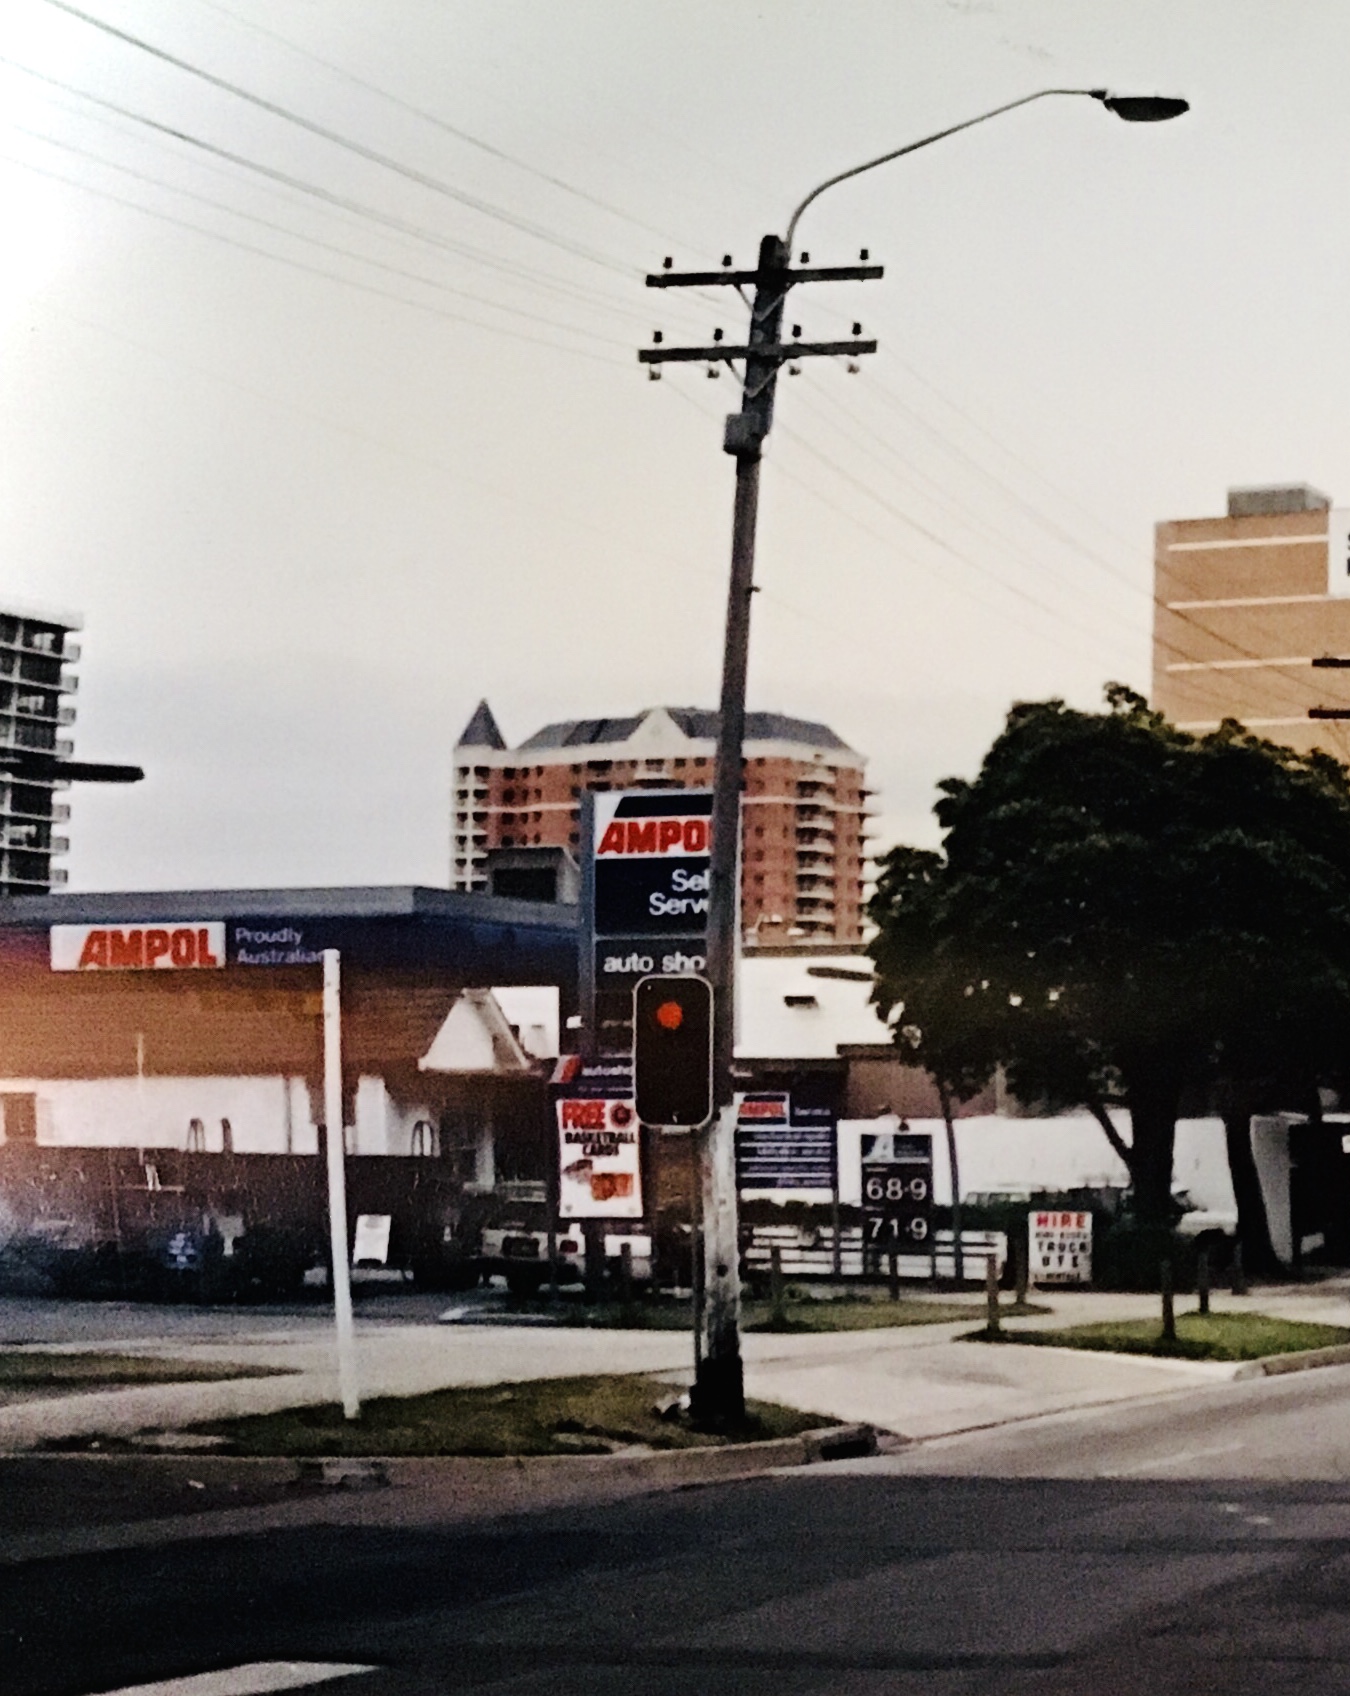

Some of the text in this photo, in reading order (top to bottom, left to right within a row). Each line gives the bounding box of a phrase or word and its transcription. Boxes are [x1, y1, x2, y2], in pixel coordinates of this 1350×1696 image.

[672, 869, 710, 892] Sel
[235, 927, 302, 945] Proudly
[79, 929, 217, 967] AMPOL
[604, 952, 706, 972] auto sho
[562, 1100, 606, 1130] FREE
[565, 1132, 635, 1144] BASKETBALL
[1036, 1213, 1086, 1228] HIRE
